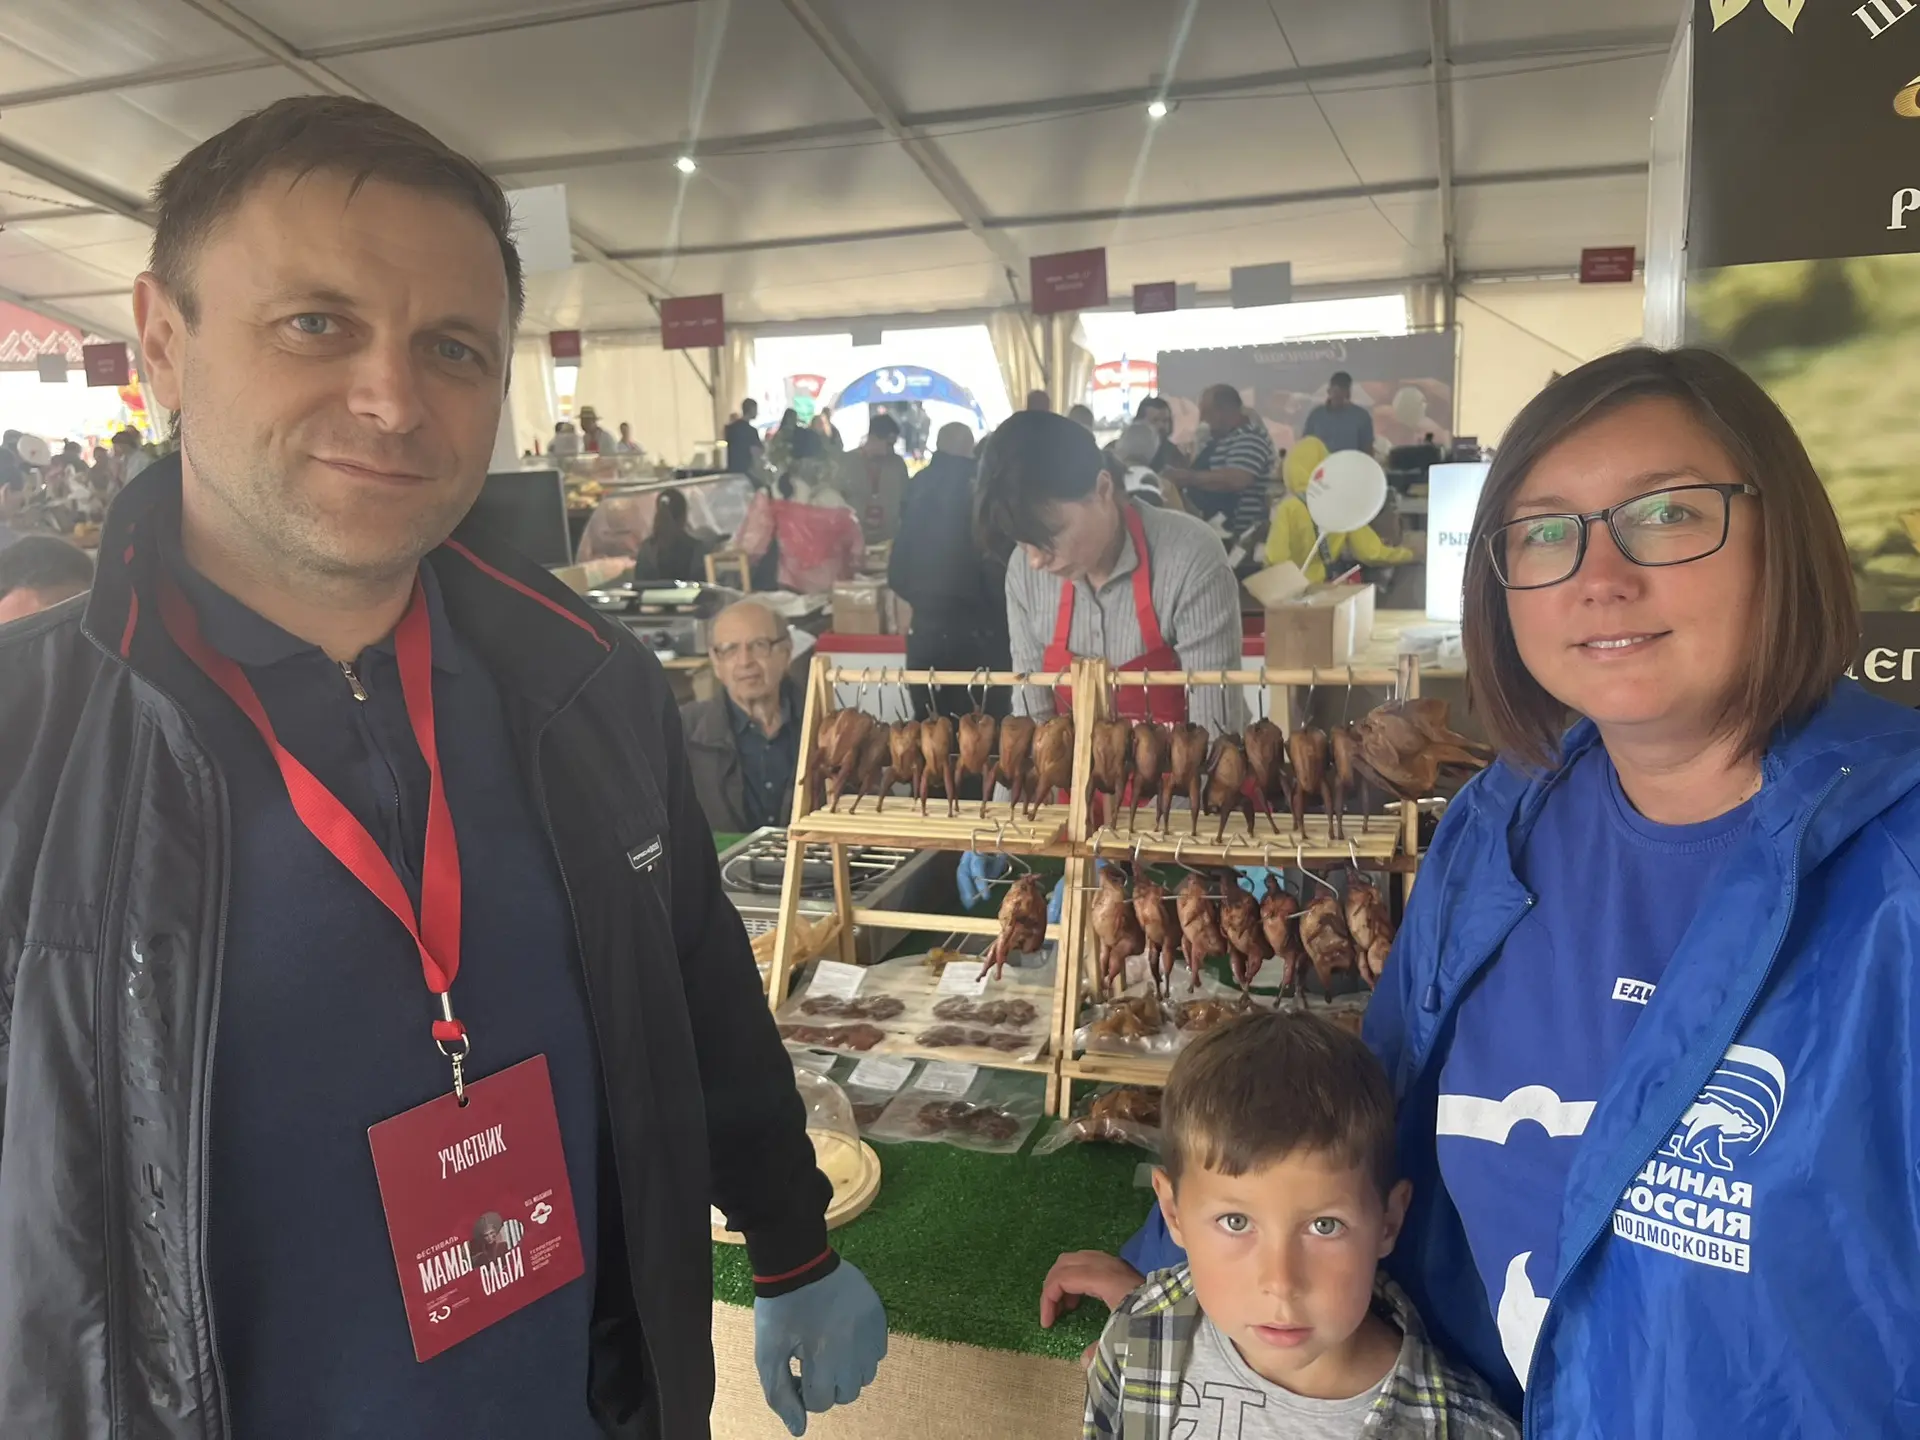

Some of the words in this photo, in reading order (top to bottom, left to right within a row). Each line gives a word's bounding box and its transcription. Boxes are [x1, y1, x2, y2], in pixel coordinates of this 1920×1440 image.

[438, 1124, 507, 1179] УЧАСТНИК
[1635, 1160, 1752, 1208] ДИНАЯ
[1615, 1213, 1745, 1267] ПОДМОСКОВЬЕ
[1623, 1187, 1750, 1240] ОССИЯ
[416, 1236, 459, 1260] ФЕСТИВАЛЬ
[418, 1240, 473, 1294] МАМЫ
[480, 1246, 525, 1296] ОЛЬГИ
